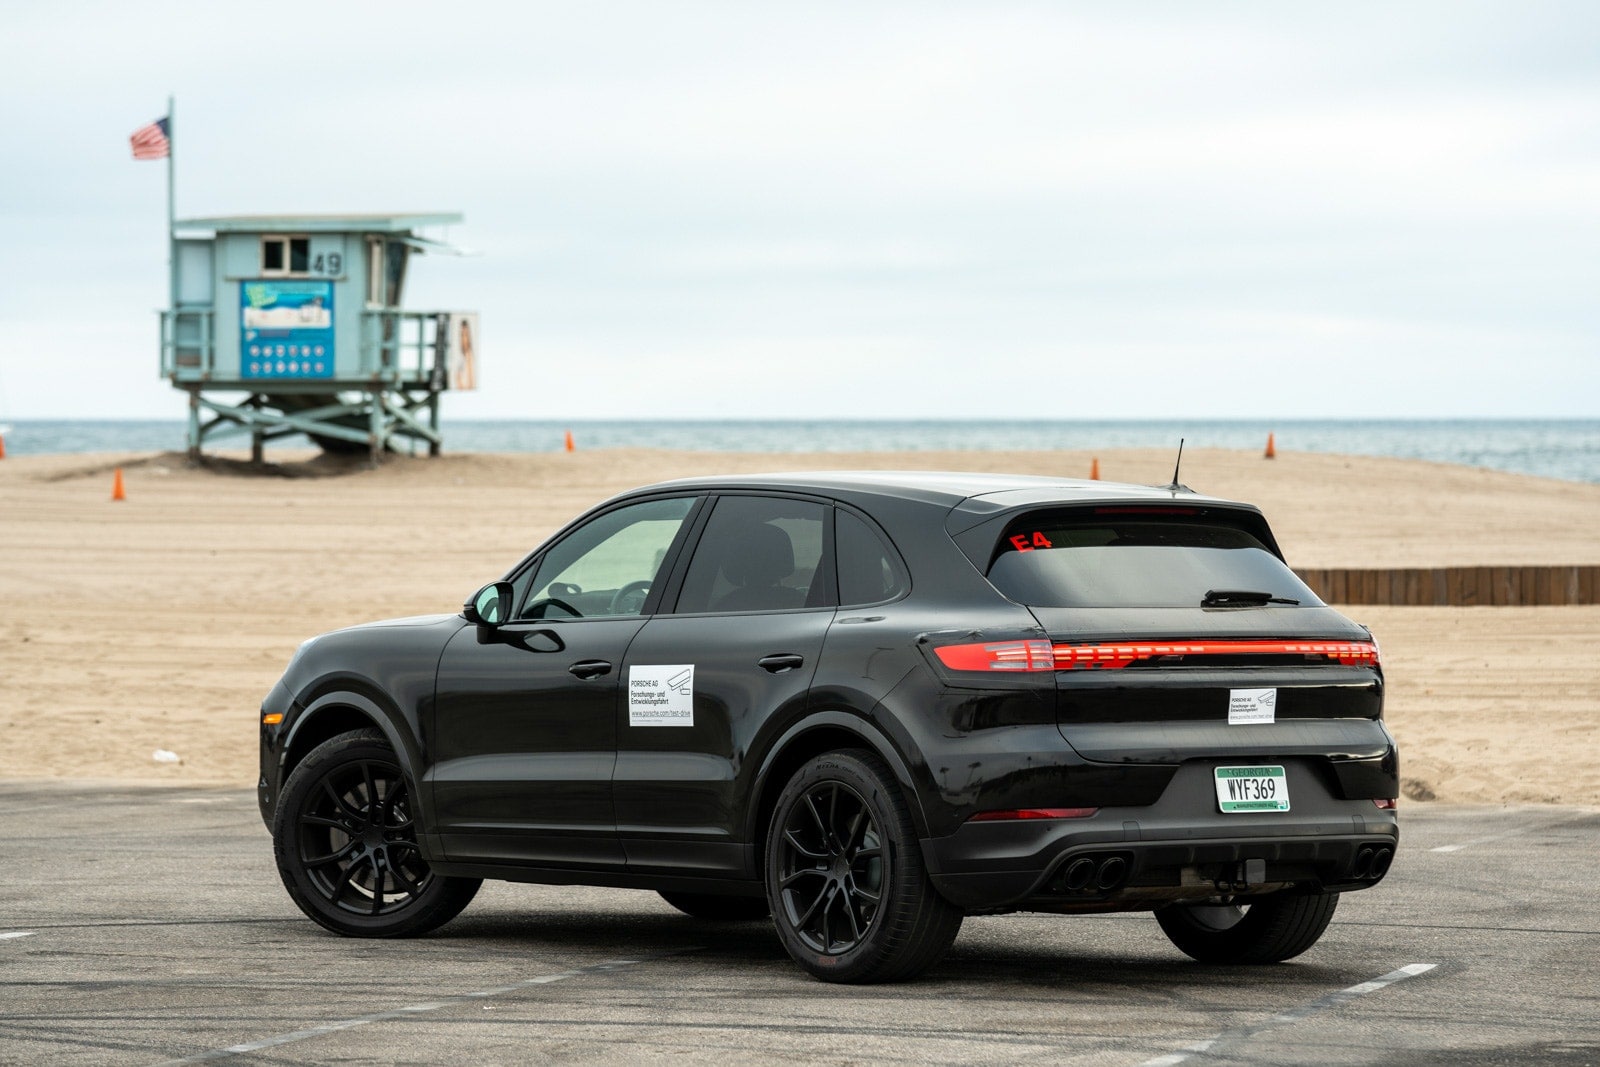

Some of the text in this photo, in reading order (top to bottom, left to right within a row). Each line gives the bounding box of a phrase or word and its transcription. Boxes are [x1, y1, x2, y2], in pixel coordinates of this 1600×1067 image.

[312, 252, 343, 275] 49
[1009, 531, 1053, 553] E4
[631, 691, 656, 699] Forschungs-
[1232, 767, 1271, 777] GEORGIA
[1228, 778, 1275, 800] WYF369
